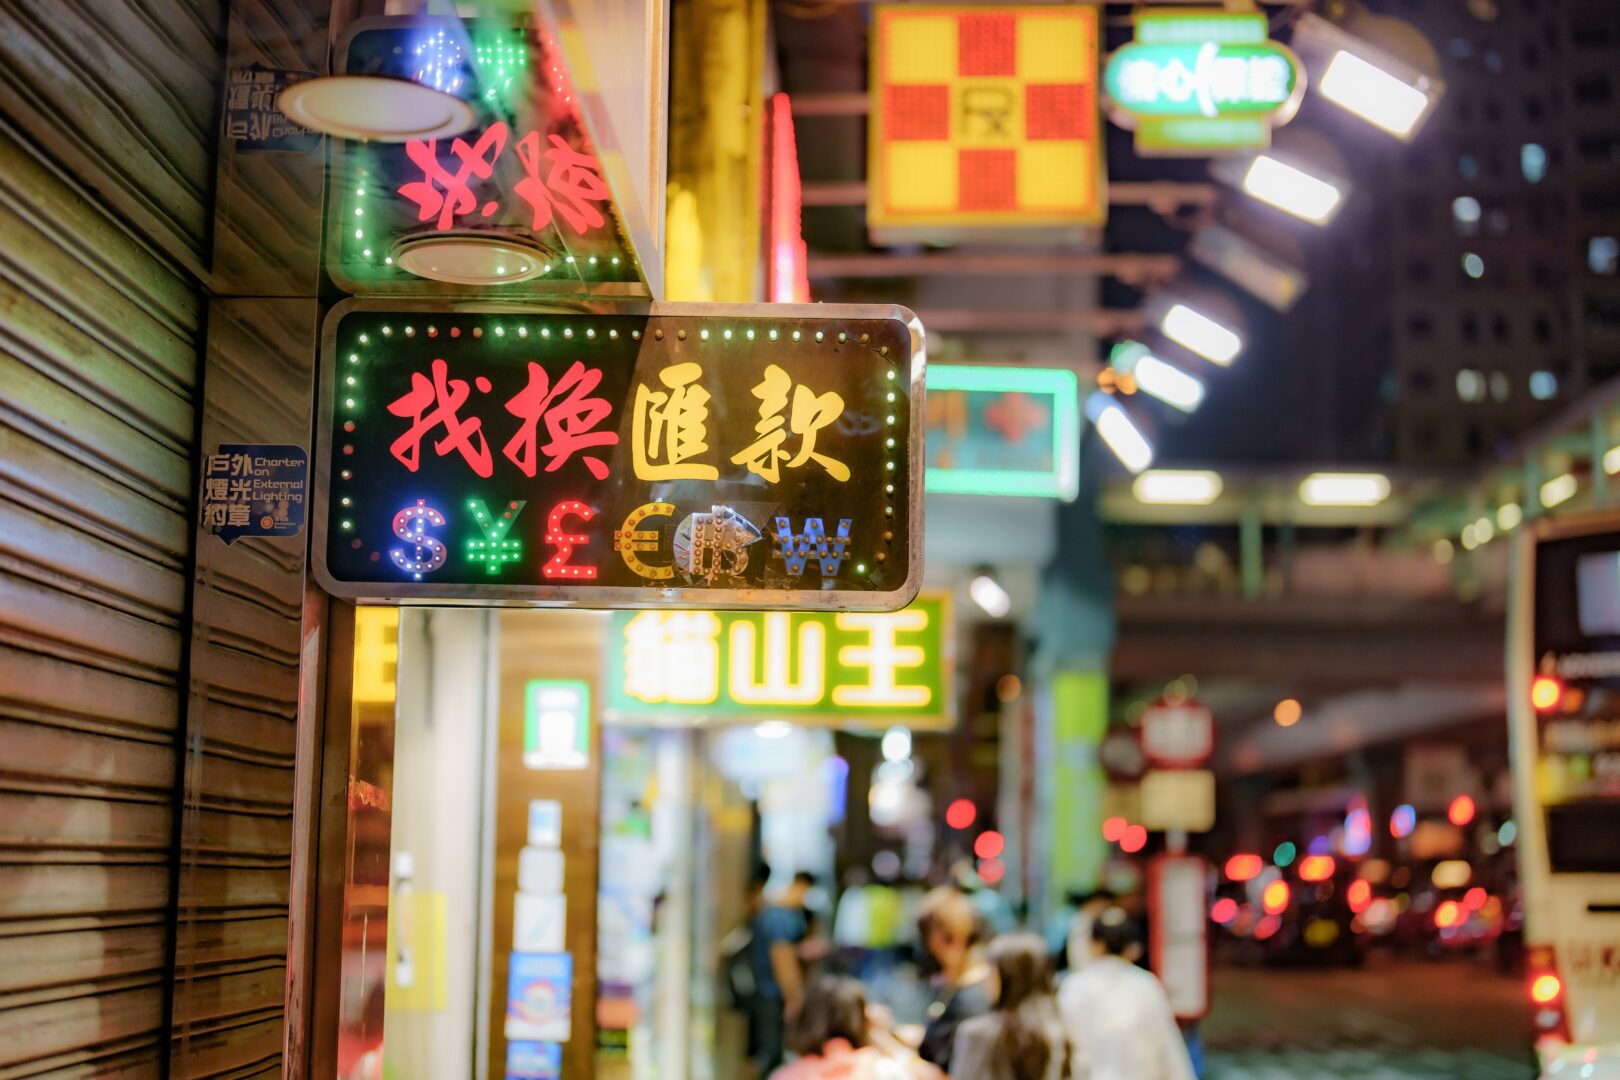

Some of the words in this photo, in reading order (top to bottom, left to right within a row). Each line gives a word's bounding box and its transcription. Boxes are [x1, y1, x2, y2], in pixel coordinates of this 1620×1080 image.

[387, 358, 851, 482] 找換匯款
[254, 457, 305, 467] Charter
[253, 479, 303, 489] External
[252, 491, 303, 503] Lighting
